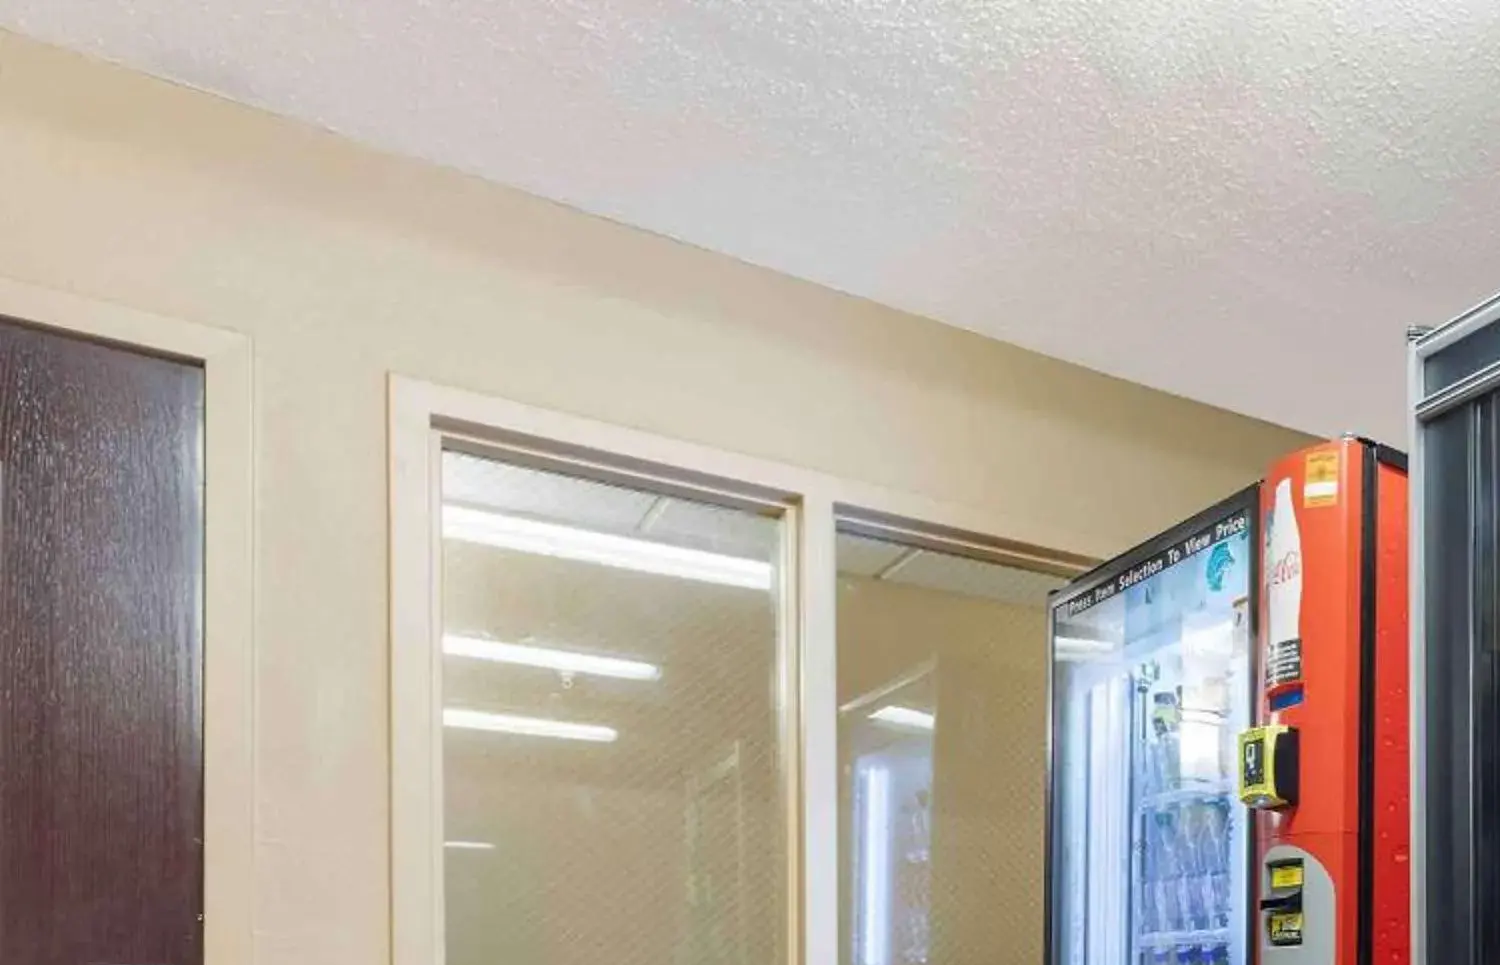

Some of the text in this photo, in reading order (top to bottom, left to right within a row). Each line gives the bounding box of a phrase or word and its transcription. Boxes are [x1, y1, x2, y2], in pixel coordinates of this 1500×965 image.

[1118, 559, 1164, 591] Selection
[1167, 548, 1181, 565] To
[1185, 533, 1211, 556] View
[1215, 516, 1246, 541] Price
